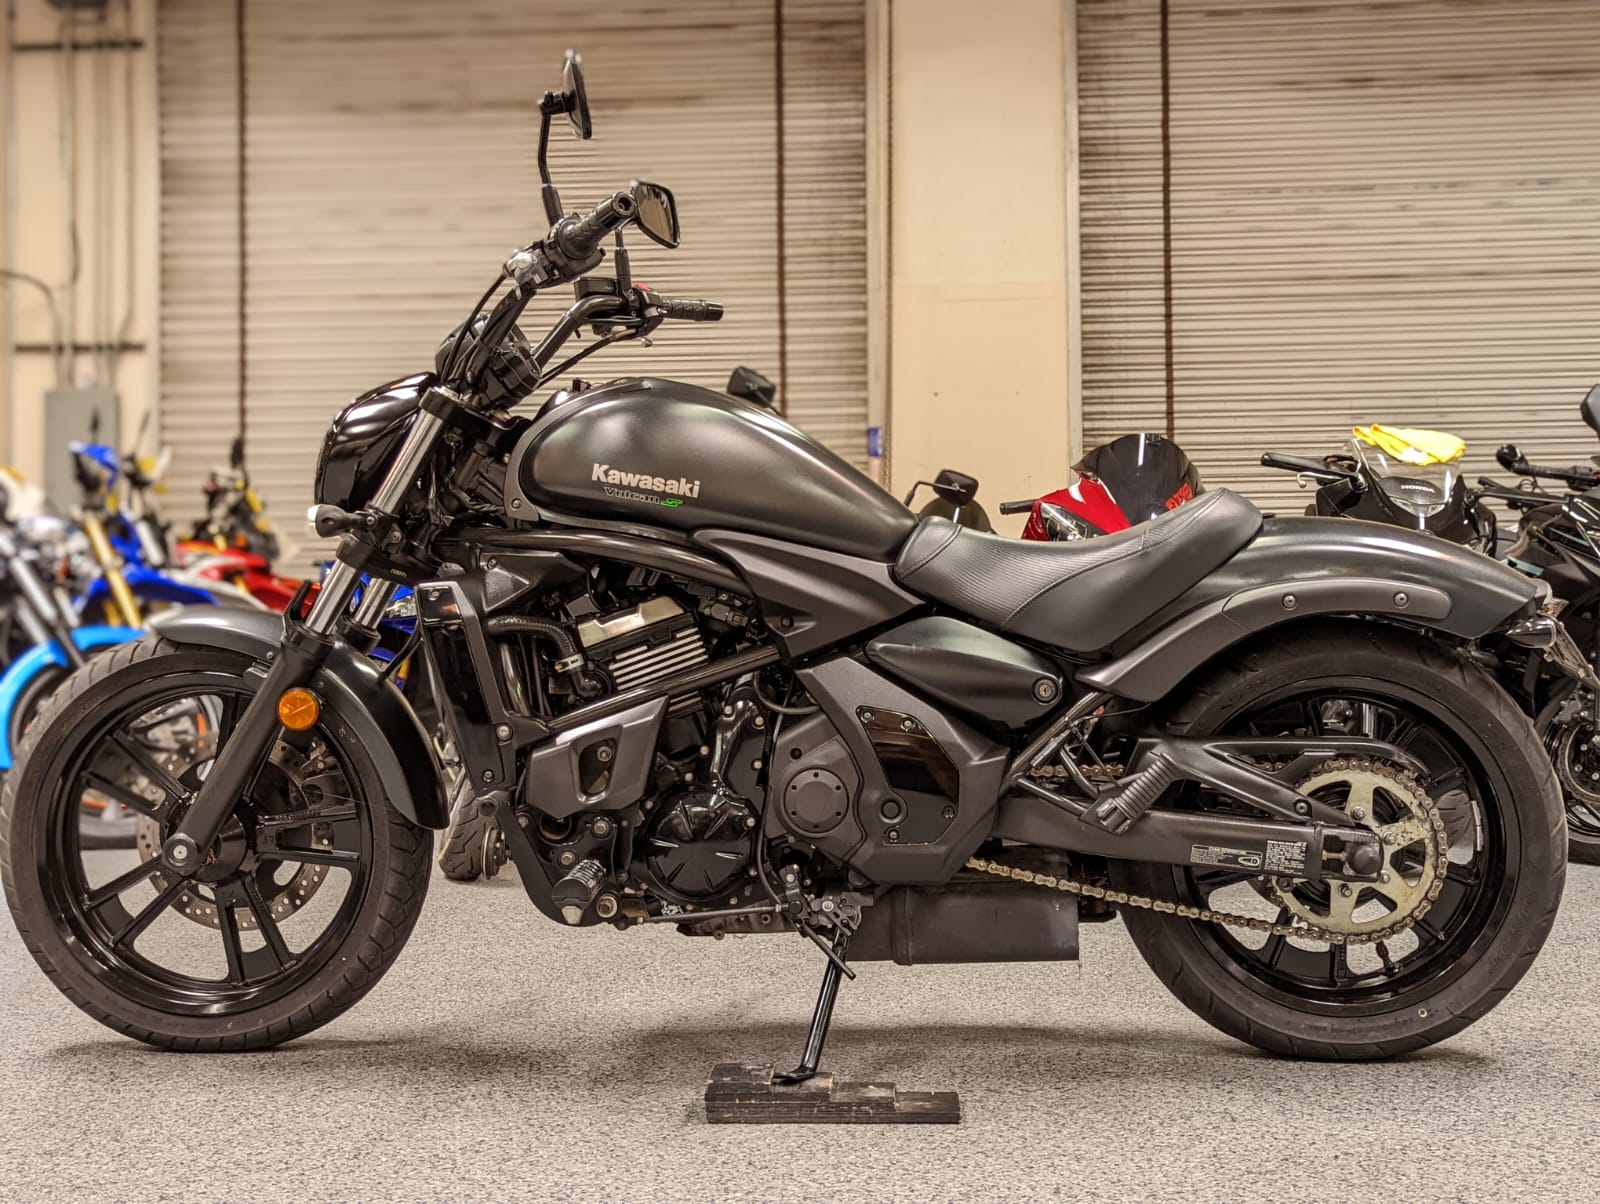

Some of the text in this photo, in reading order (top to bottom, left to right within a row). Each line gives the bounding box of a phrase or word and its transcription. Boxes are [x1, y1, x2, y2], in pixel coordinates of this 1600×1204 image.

[591, 463, 701, 499] Kawasaki
[1400, 484, 1436, 494] HONDA
[603, 486, 660, 505] Vulcan
